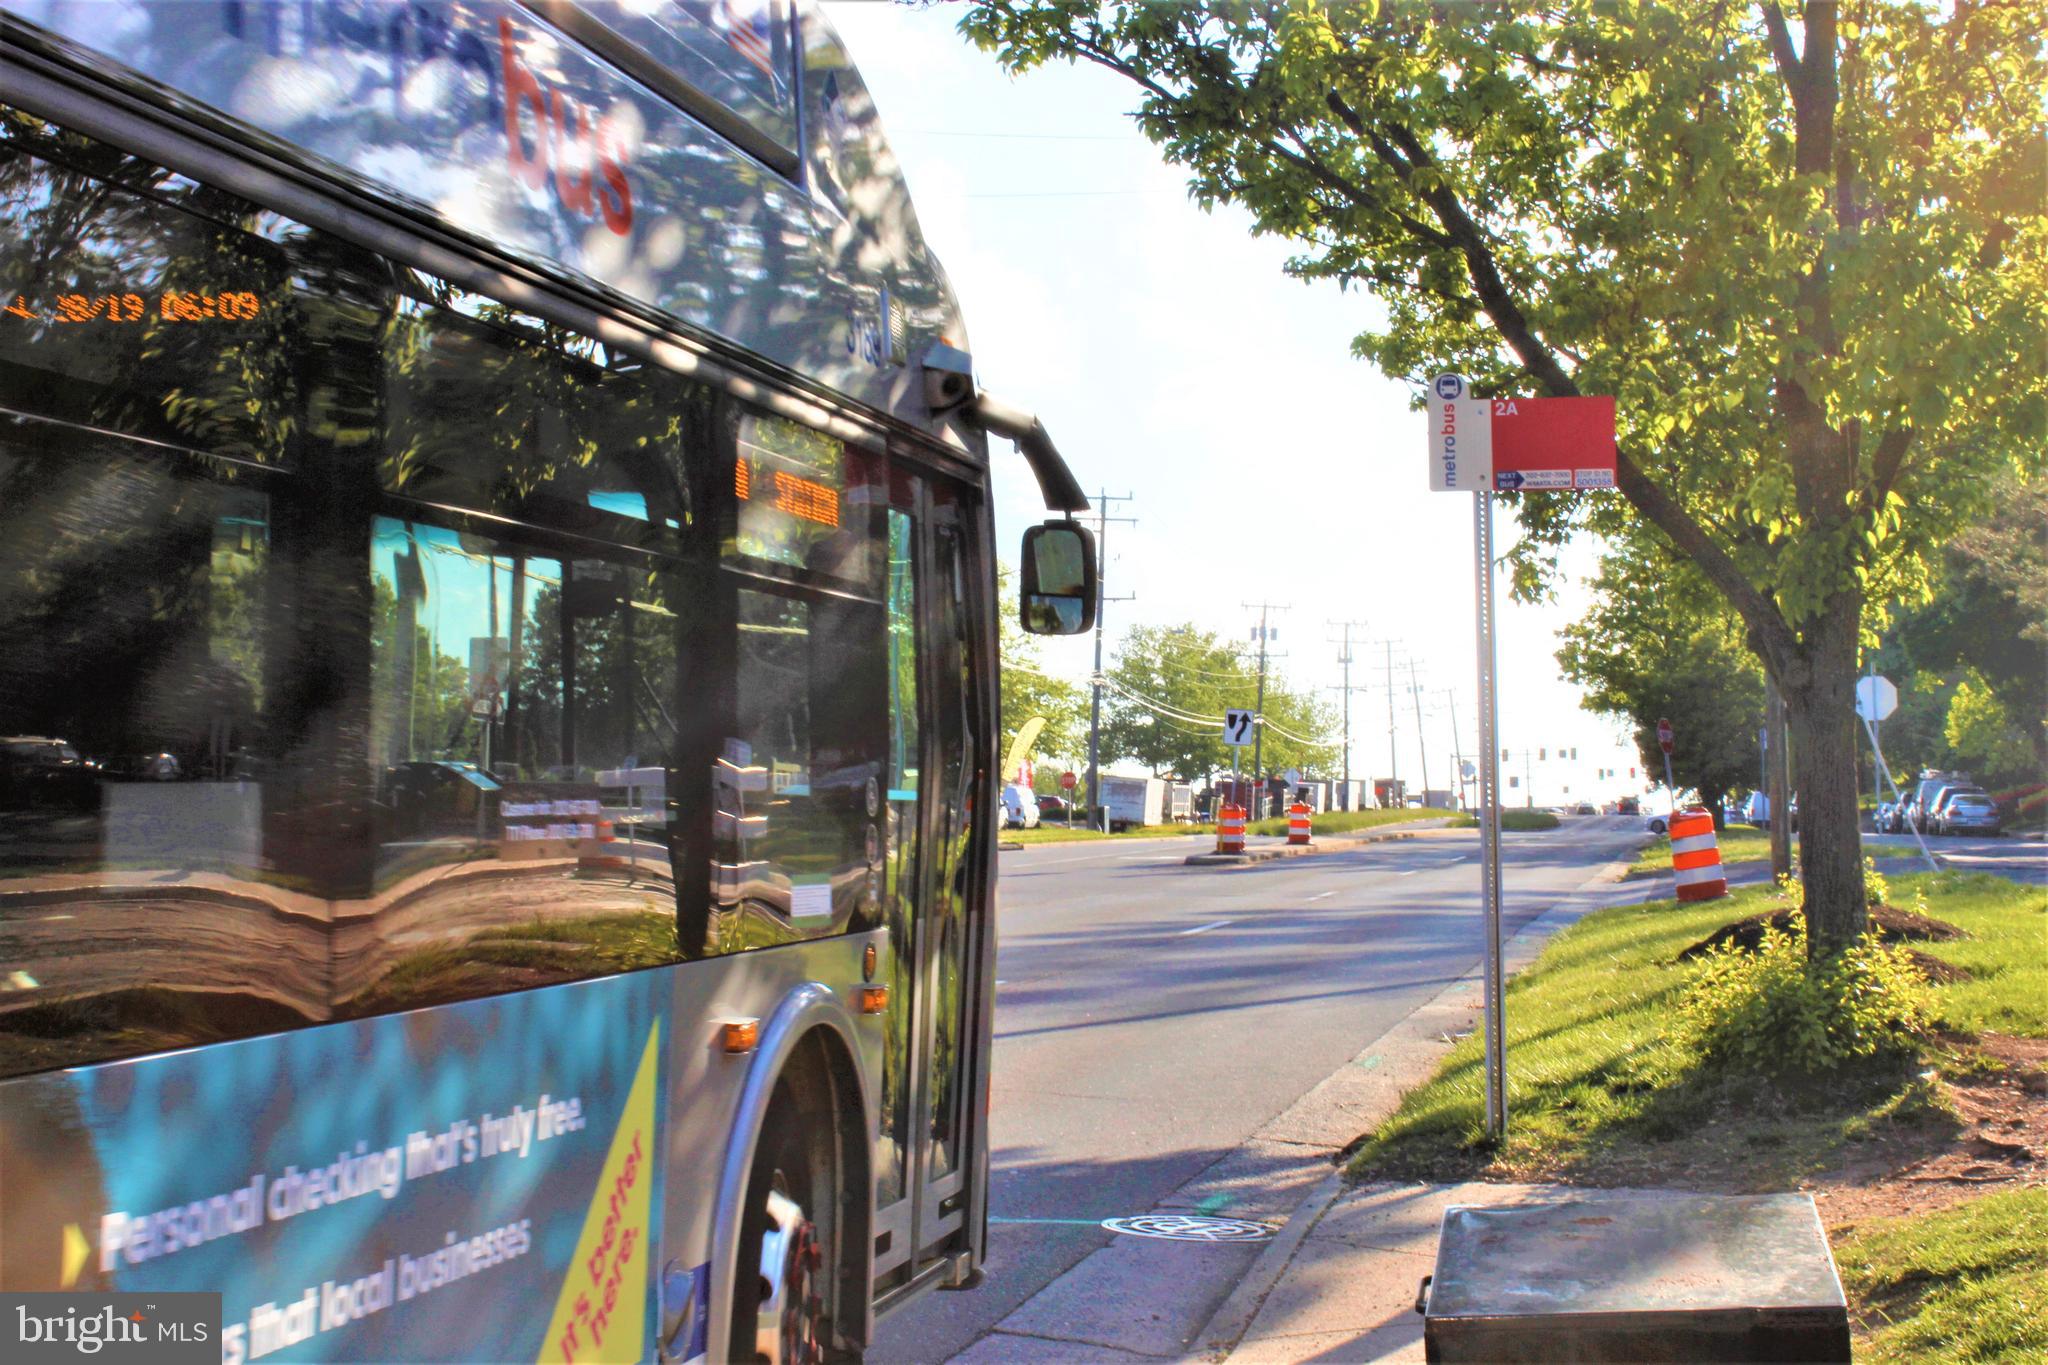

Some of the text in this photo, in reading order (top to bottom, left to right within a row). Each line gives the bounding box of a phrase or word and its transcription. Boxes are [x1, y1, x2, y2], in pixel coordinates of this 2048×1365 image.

[498, 15, 634, 236] bus
[160, 292, 260, 322] 06:09
[1441, 403, 1457, 488] metrobus
[1495, 402, 1519, 416] 2A
[99, 1093, 587, 1272] Personal checking that's truly free.
[586, 1128, 643, 1290] better
[248, 1286, 320, 1361] that
[318, 1258, 396, 1333] local
[397, 1218, 533, 1303] businesses
